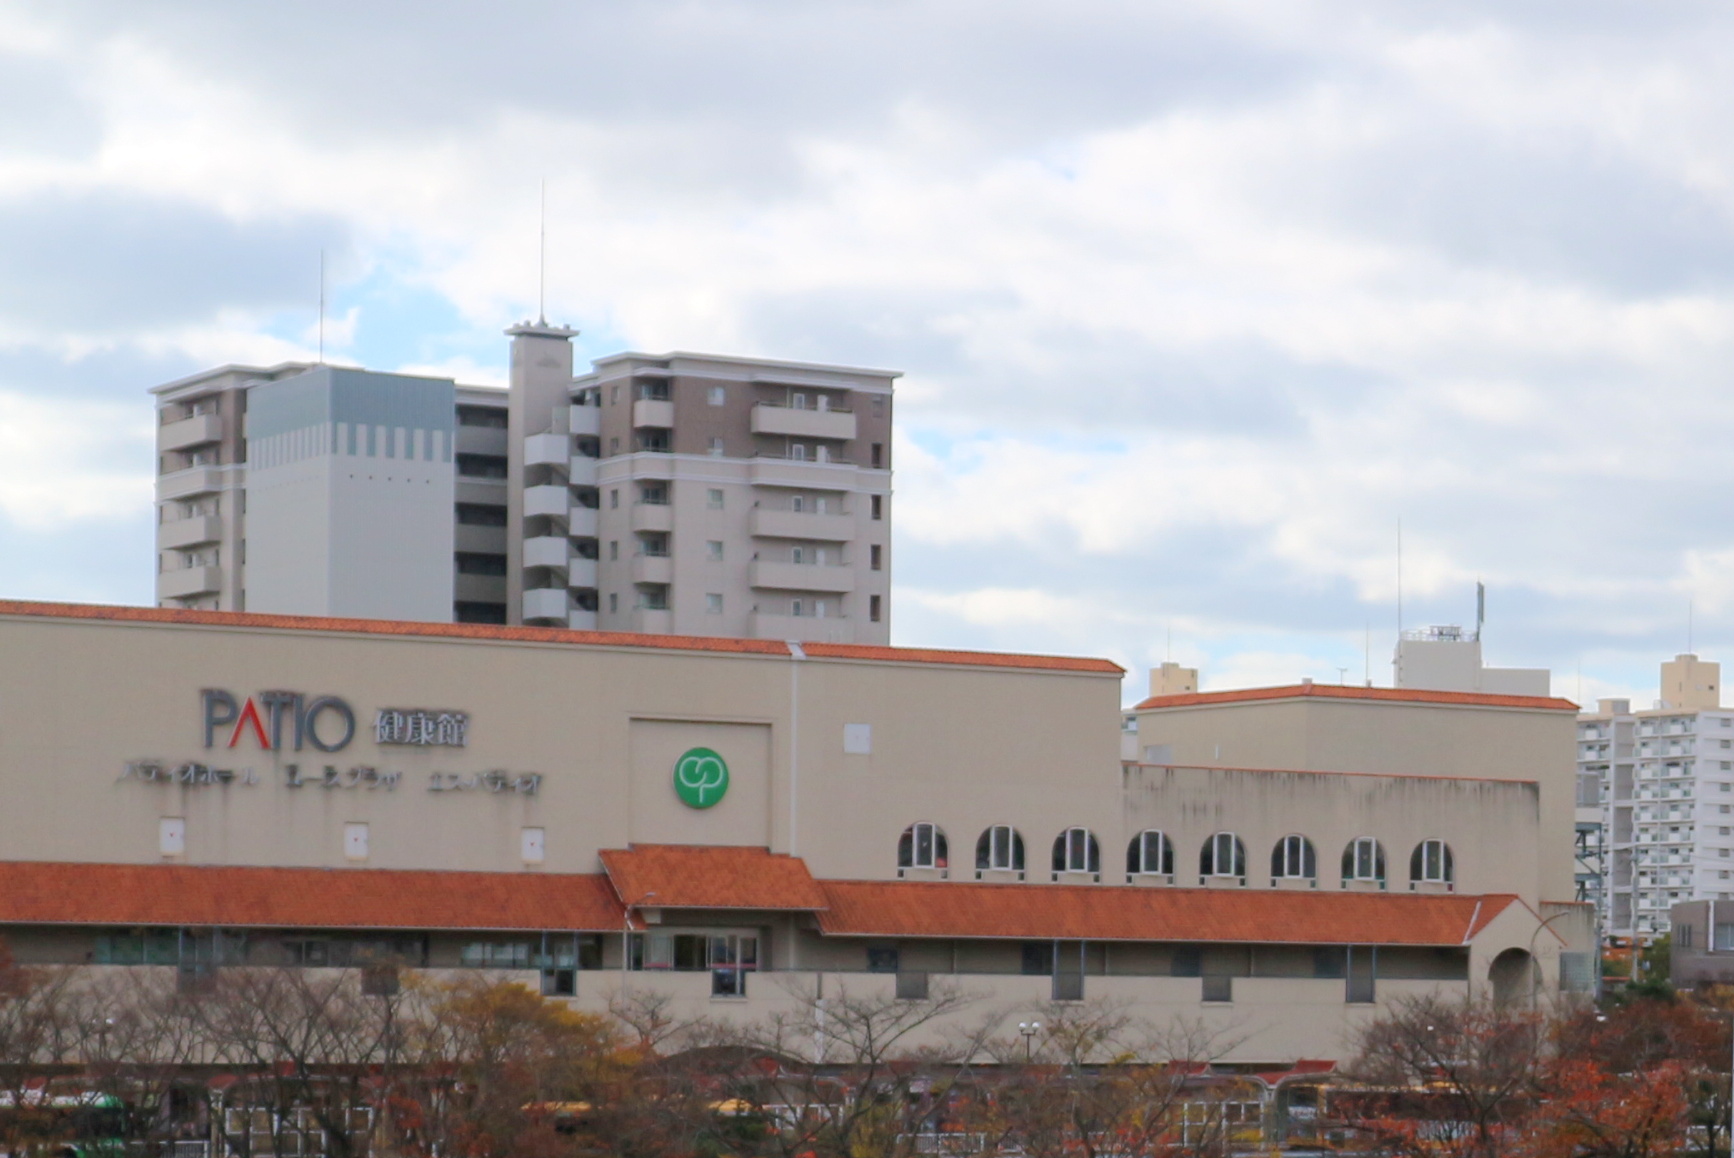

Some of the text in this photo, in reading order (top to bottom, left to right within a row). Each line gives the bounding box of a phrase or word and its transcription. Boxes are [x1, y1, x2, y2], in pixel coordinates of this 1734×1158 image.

[202, 689, 468, 752] PATIO 健康館
